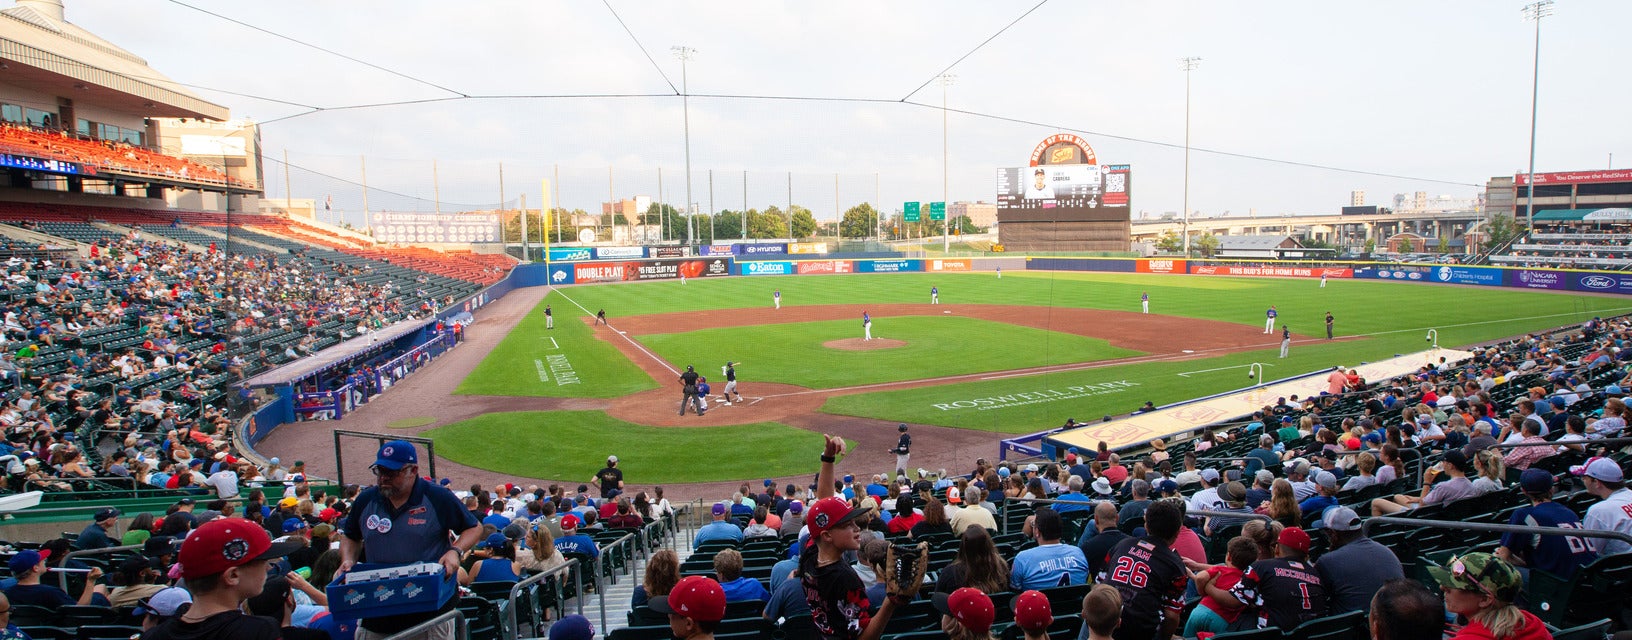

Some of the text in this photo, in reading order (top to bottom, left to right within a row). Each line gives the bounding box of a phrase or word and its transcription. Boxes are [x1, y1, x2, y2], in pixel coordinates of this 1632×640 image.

[1058, 134, 1074, 142] THE
[757, 262, 784, 271] Eaton
[1294, 268, 1312, 276] RUNS
[577, 266, 624, 279] DOUBLE PLAY!
[1474, 273, 1494, 281] Hospital
[1530, 271, 1558, 279] NIAGARA
[1586, 276, 1610, 287] Ford
[931, 380, 1141, 411] ROSWELL PARK
[555, 541, 578, 551] PILLAR
[1128, 546, 1152, 561] LAM
[1040, 556, 1078, 573] PHILLIPS
[1112, 556, 1151, 588] 26
[1299, 582, 1312, 609] 1
